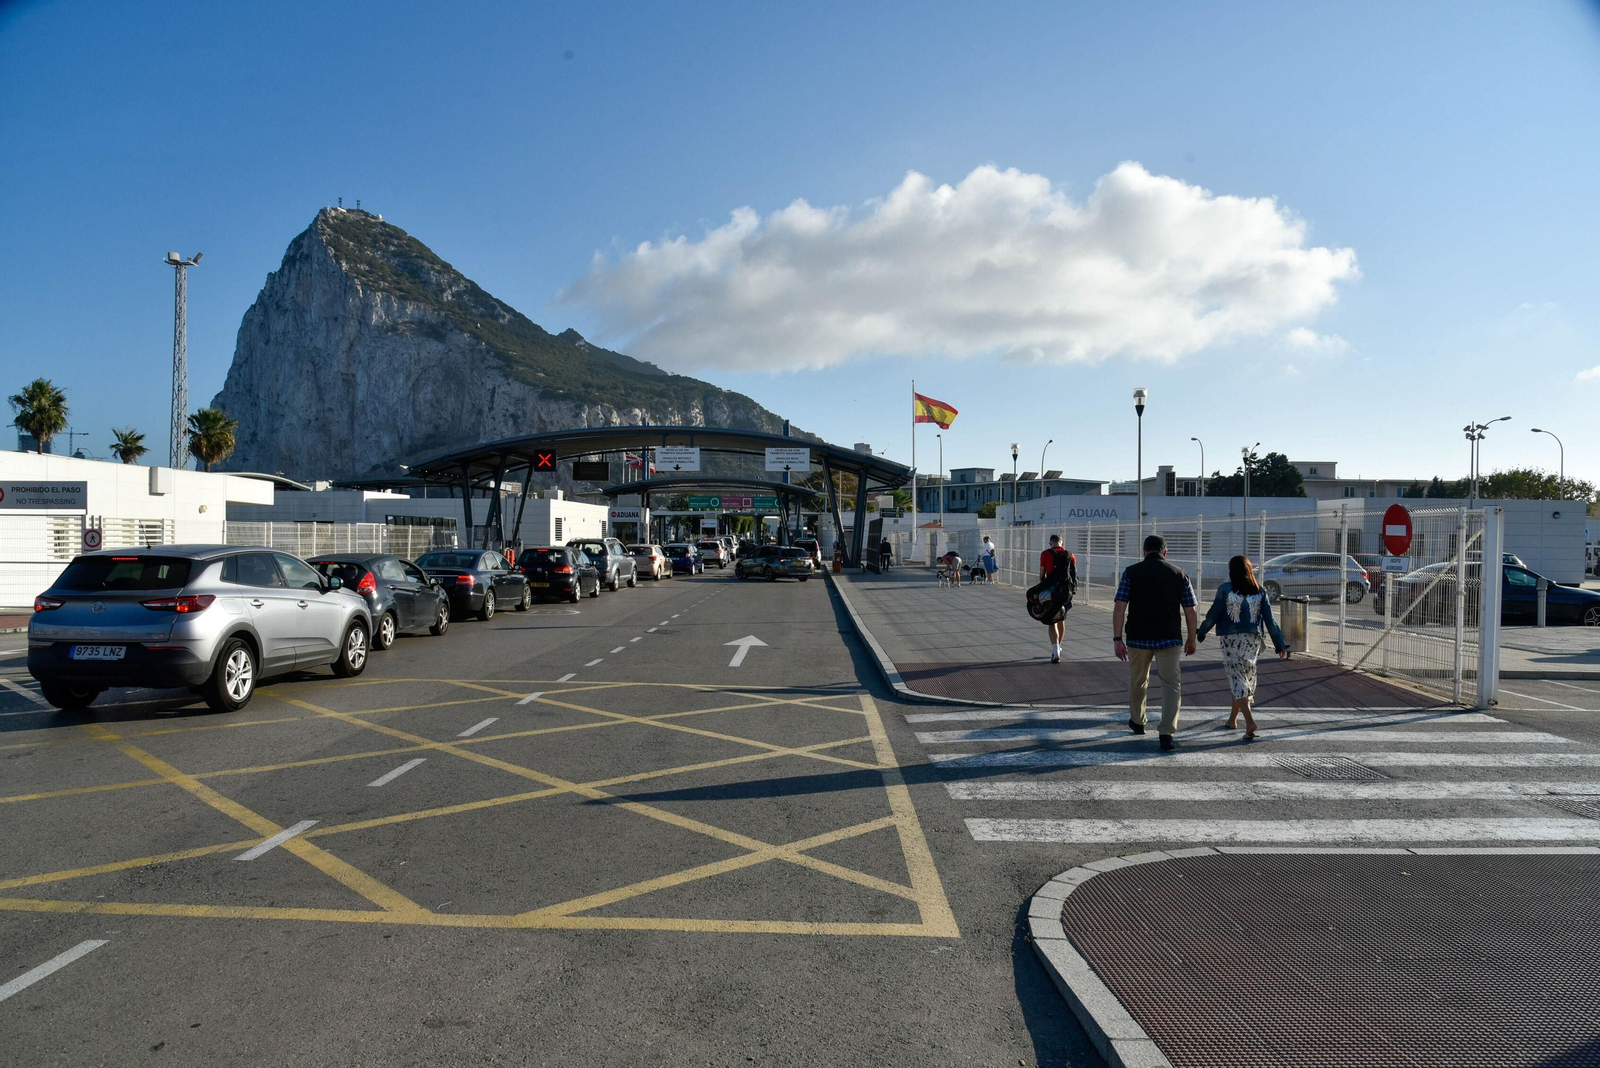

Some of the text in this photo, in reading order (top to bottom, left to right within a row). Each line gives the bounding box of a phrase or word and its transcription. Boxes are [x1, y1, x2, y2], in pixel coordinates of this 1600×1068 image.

[1068, 508, 1118, 518] ADUANA
[76, 647, 123, 656] 9735 LNZ
